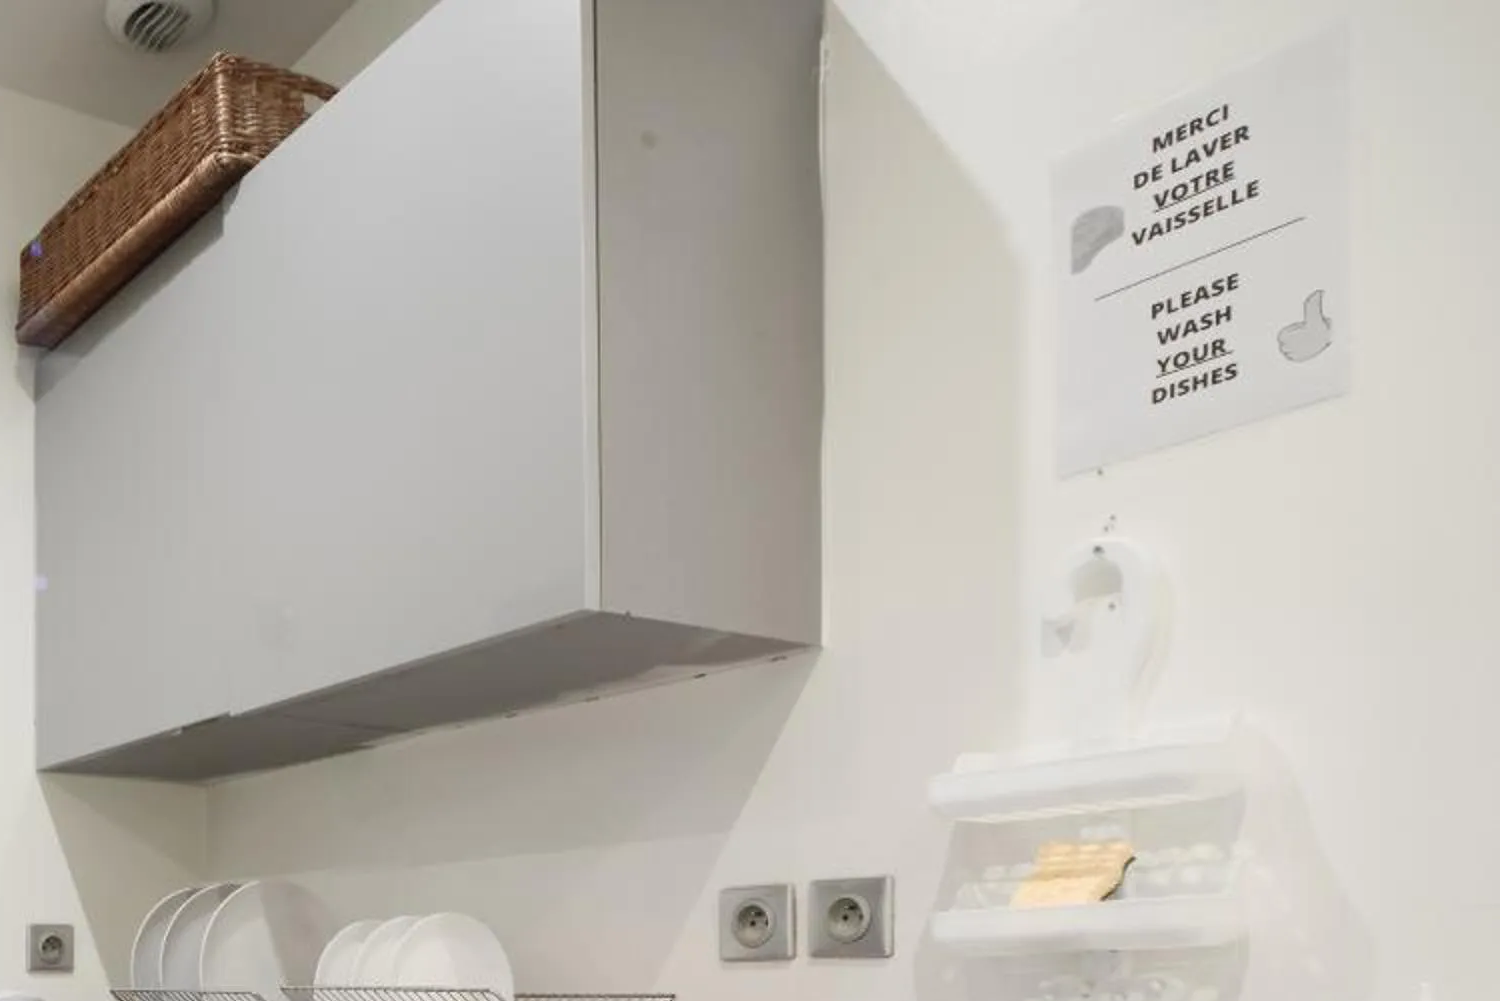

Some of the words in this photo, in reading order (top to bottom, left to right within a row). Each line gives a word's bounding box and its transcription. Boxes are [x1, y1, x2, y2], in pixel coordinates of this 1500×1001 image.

[1152, 104, 1229, 153] MERCI
[1133, 163, 1163, 190] DE
[1171, 125, 1250, 174] LAVER
[1153, 161, 1236, 210] VOTRE
[1131, 180, 1260, 246] VAISSELLE
[1151, 273, 1240, 320] PLEASE
[1157, 306, 1232, 345] WASH
[1156, 338, 1229, 376] YOUR
[1151, 363, 1238, 405] DISHES
